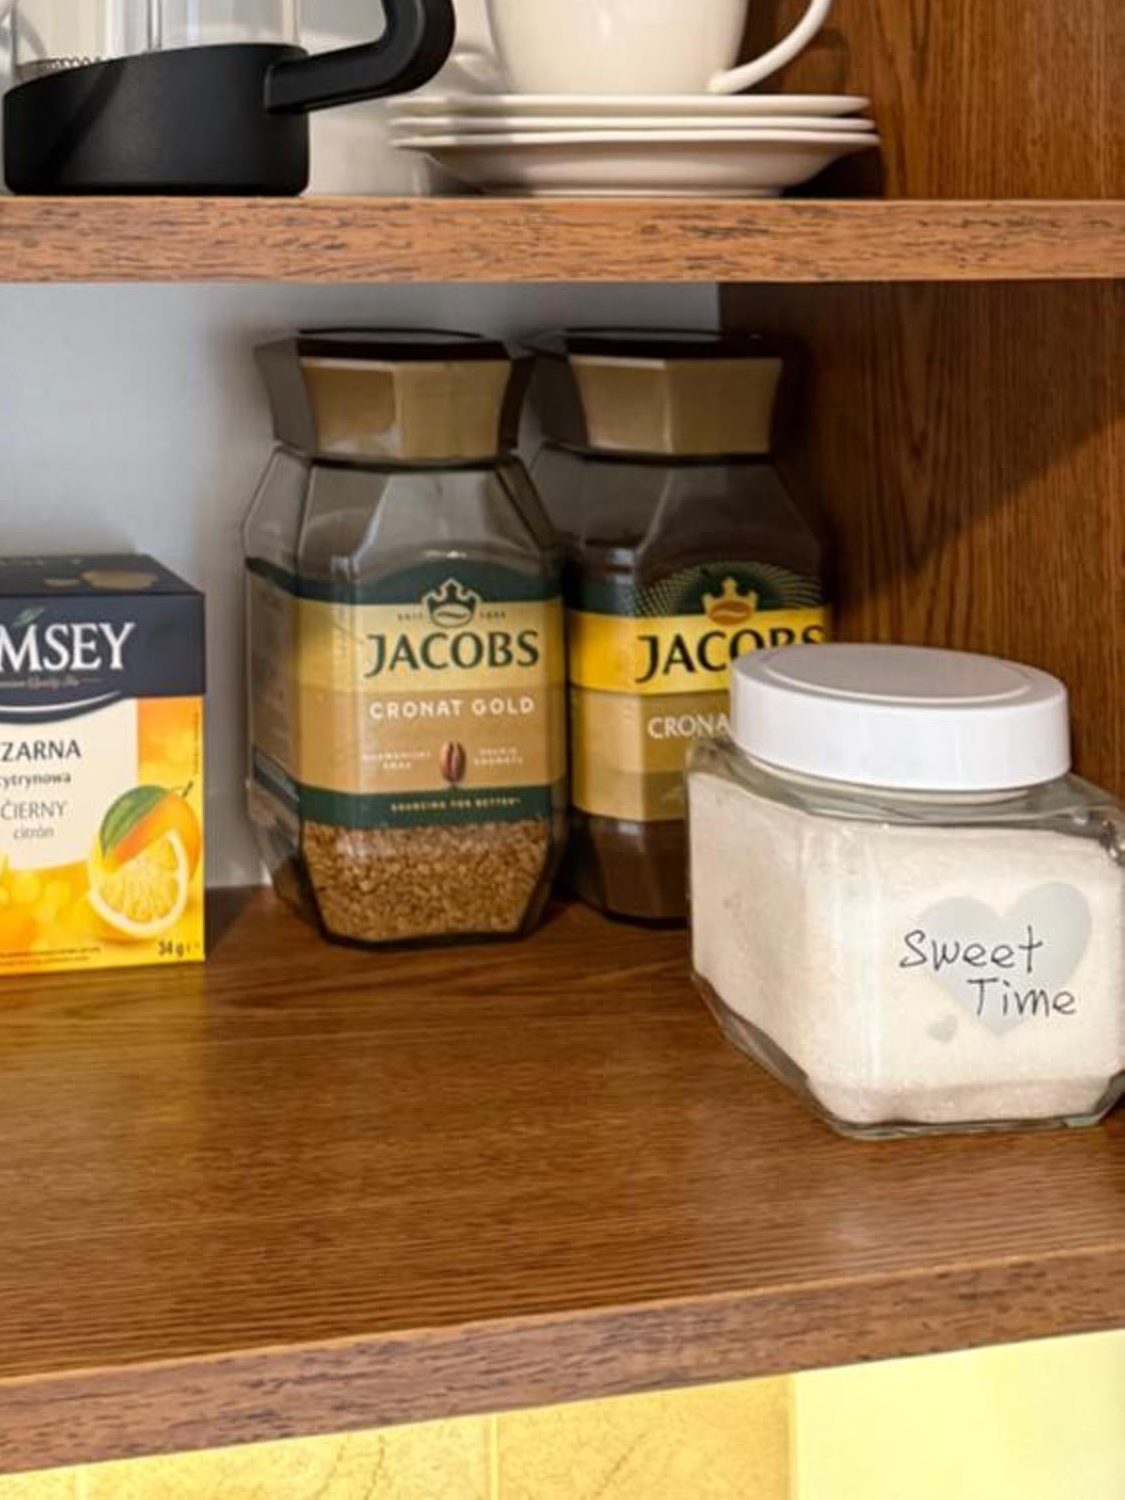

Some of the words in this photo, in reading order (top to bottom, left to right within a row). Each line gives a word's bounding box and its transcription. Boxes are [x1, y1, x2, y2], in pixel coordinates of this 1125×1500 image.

[363, 629, 540, 680] JACOBS
[369, 699, 464, 720] CRONAT
[471, 696, 535, 716] GOLD
[647, 712, 732, 739] CRONA
[899, 925, 1043, 974] Sweet
[967, 977, 1078, 1018] Time
